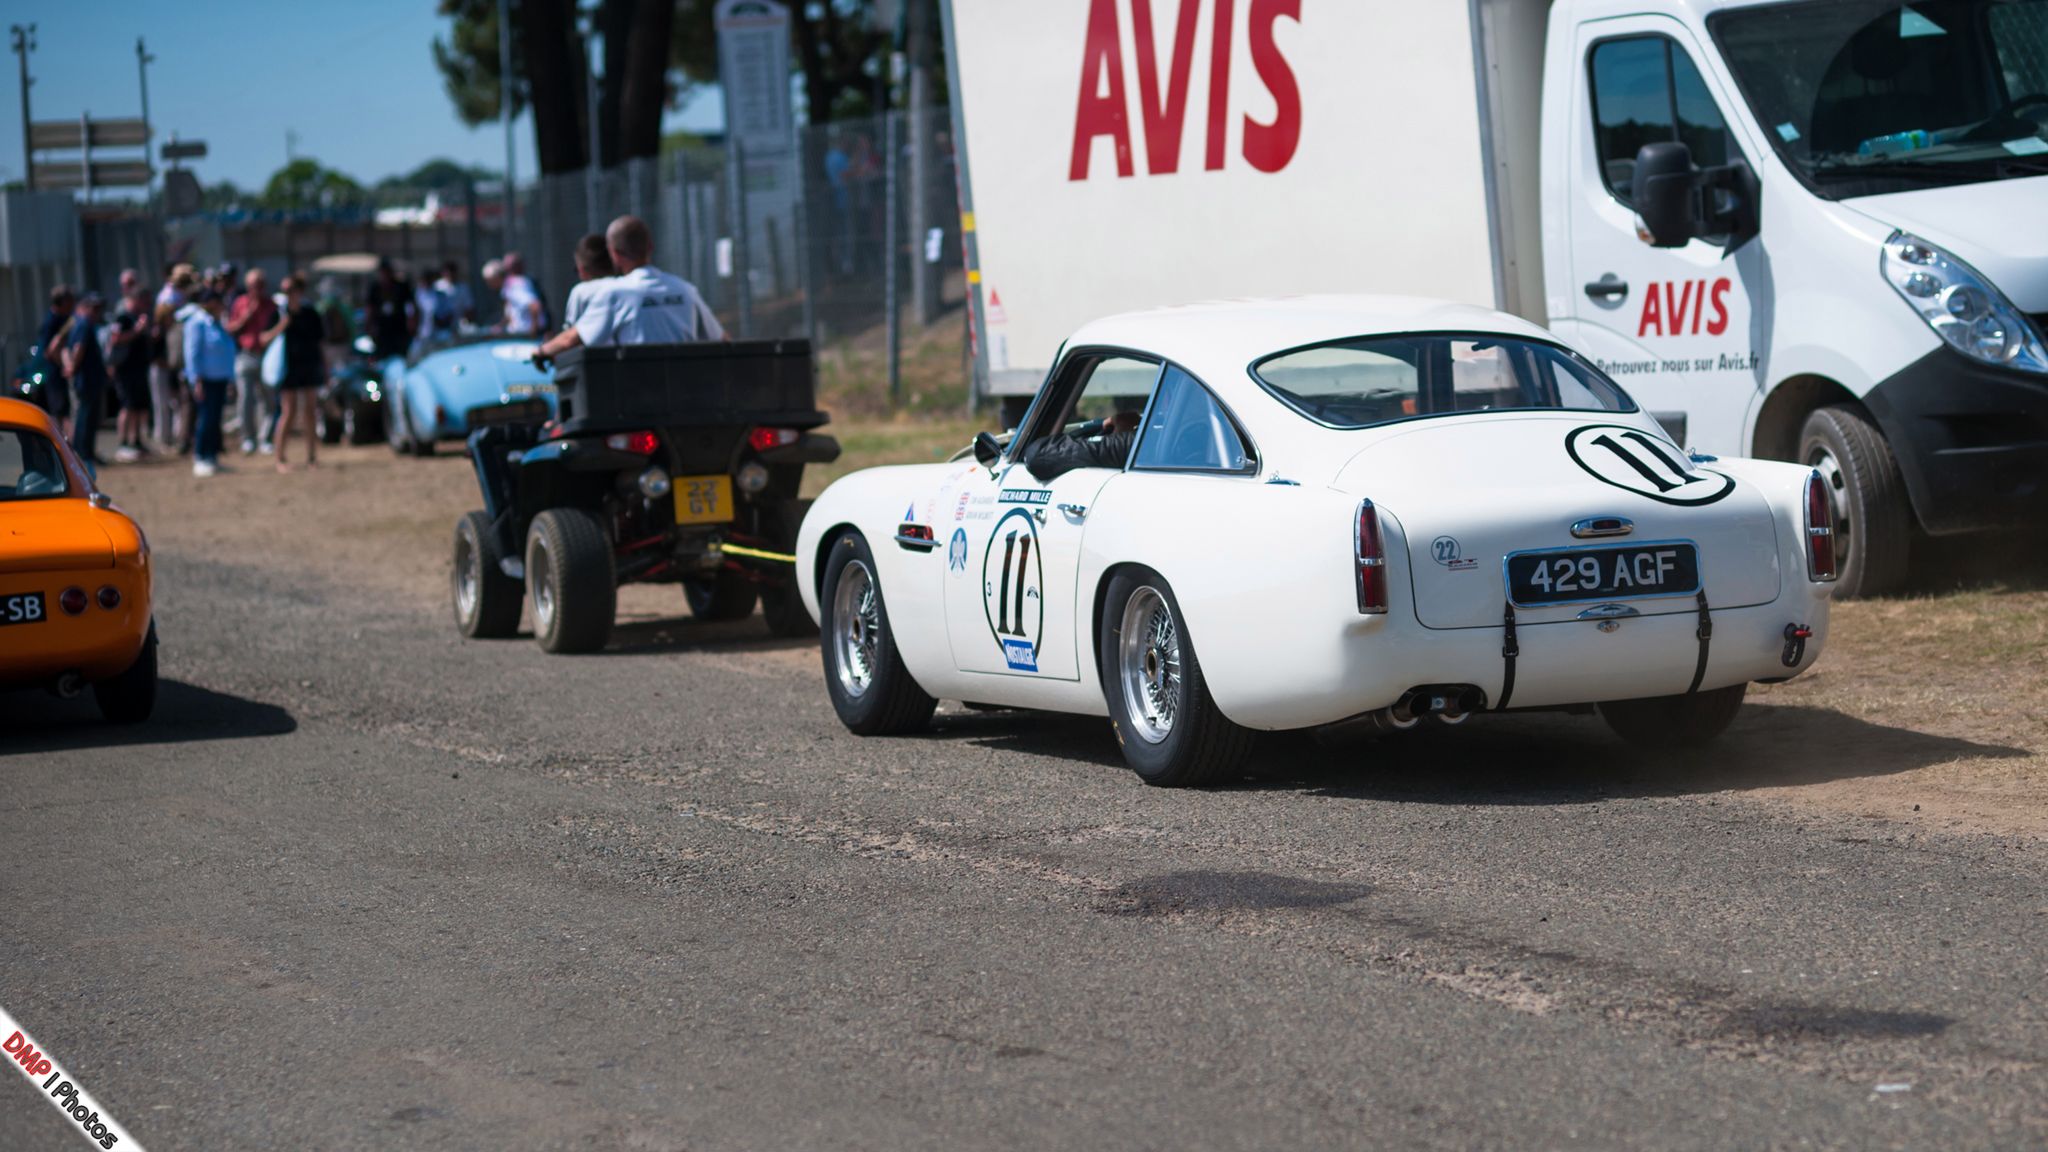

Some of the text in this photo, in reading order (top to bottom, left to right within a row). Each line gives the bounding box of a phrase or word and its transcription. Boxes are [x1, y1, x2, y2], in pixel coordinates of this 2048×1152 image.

[1068, 0, 1302, 181] AVIS
[1637, 277, 1732, 337] AVIS
[1661, 358, 1690, 373] nous
[1694, 358, 1714, 371] sur
[1718, 351, 1760, 371] Avis.fr
[1590, 431, 1708, 493] 11
[999, 490, 1030, 502] RICHARD
[1028, 490, 1052, 504] MILLE
[1435, 540, 1456, 561] 22
[1530, 550, 1677, 593] 429 AGF
[997, 529, 1031, 637] 11
